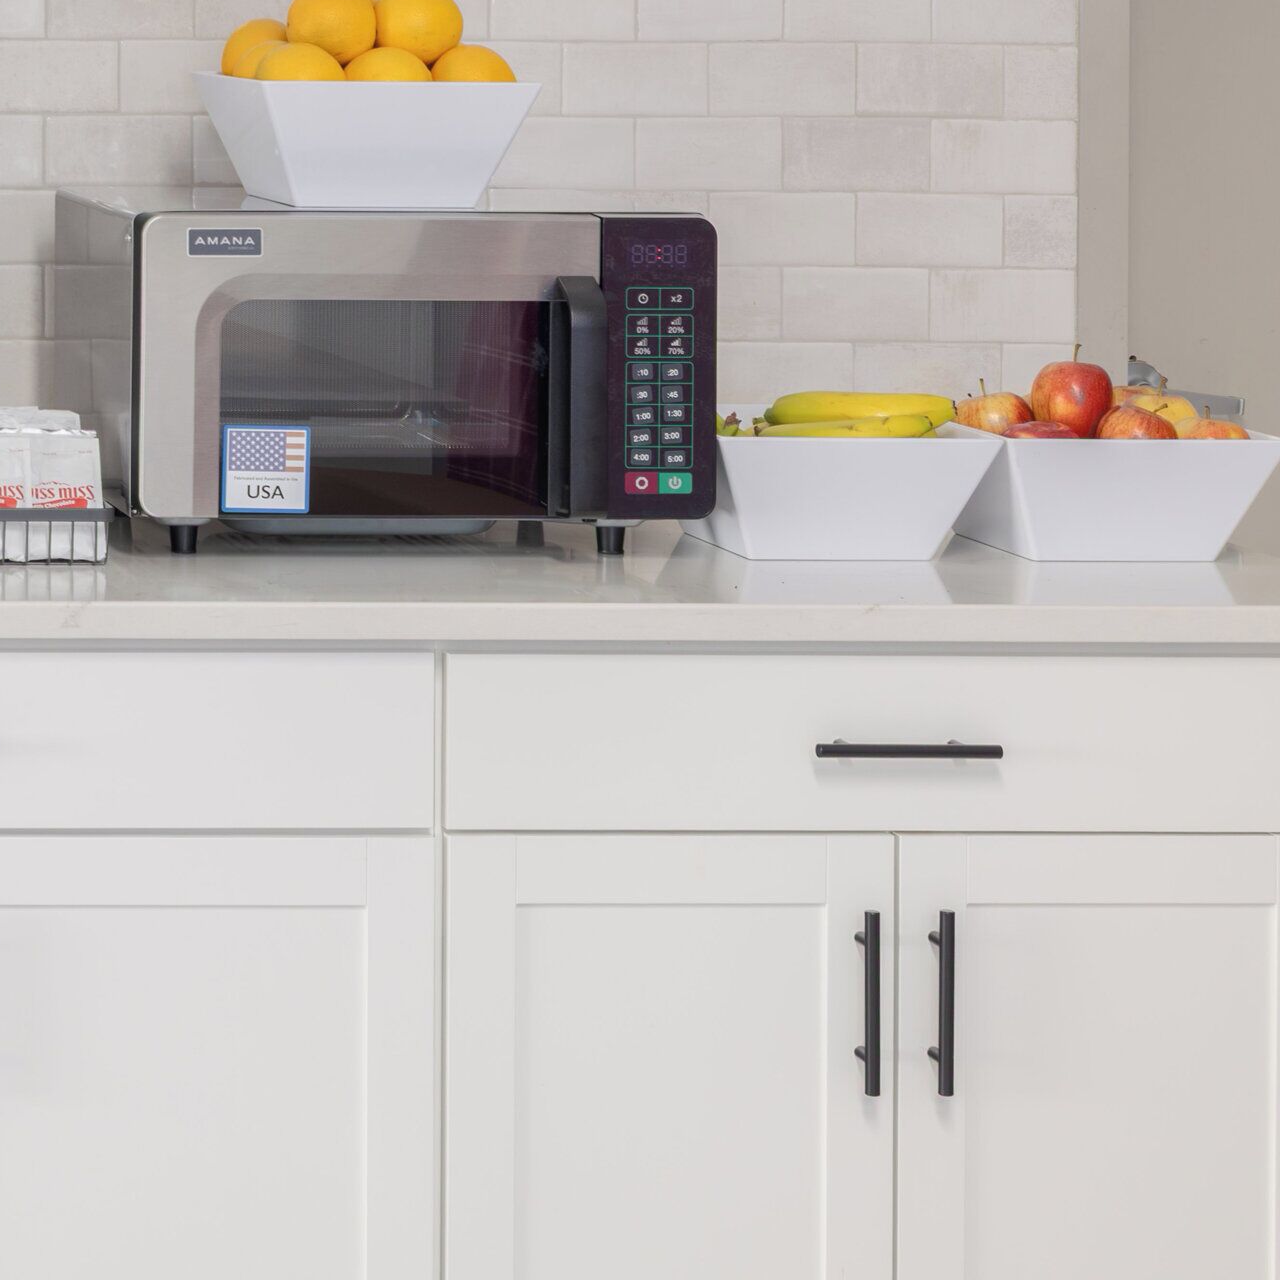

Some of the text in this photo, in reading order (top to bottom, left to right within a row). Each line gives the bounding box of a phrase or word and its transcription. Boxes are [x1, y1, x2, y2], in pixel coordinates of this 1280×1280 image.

[194, 236, 256, 246] AMANA
[670, 294, 683, 303] x2
[636, 326, 649, 334] 0%
[668, 326, 685, 334] 20%
[634, 347, 651, 355] 50%
[668, 347, 685, 355] 70%
[635, 412, 651, 421] 1:00
[667, 409, 683, 417] 1:30
[633, 434, 649, 443] 2:00
[664, 431, 680, 440] 3:00
[633, 453, 650, 461] 4:00
[667, 455, 683, 463] 5:00
[247, 484, 285, 500] USA
